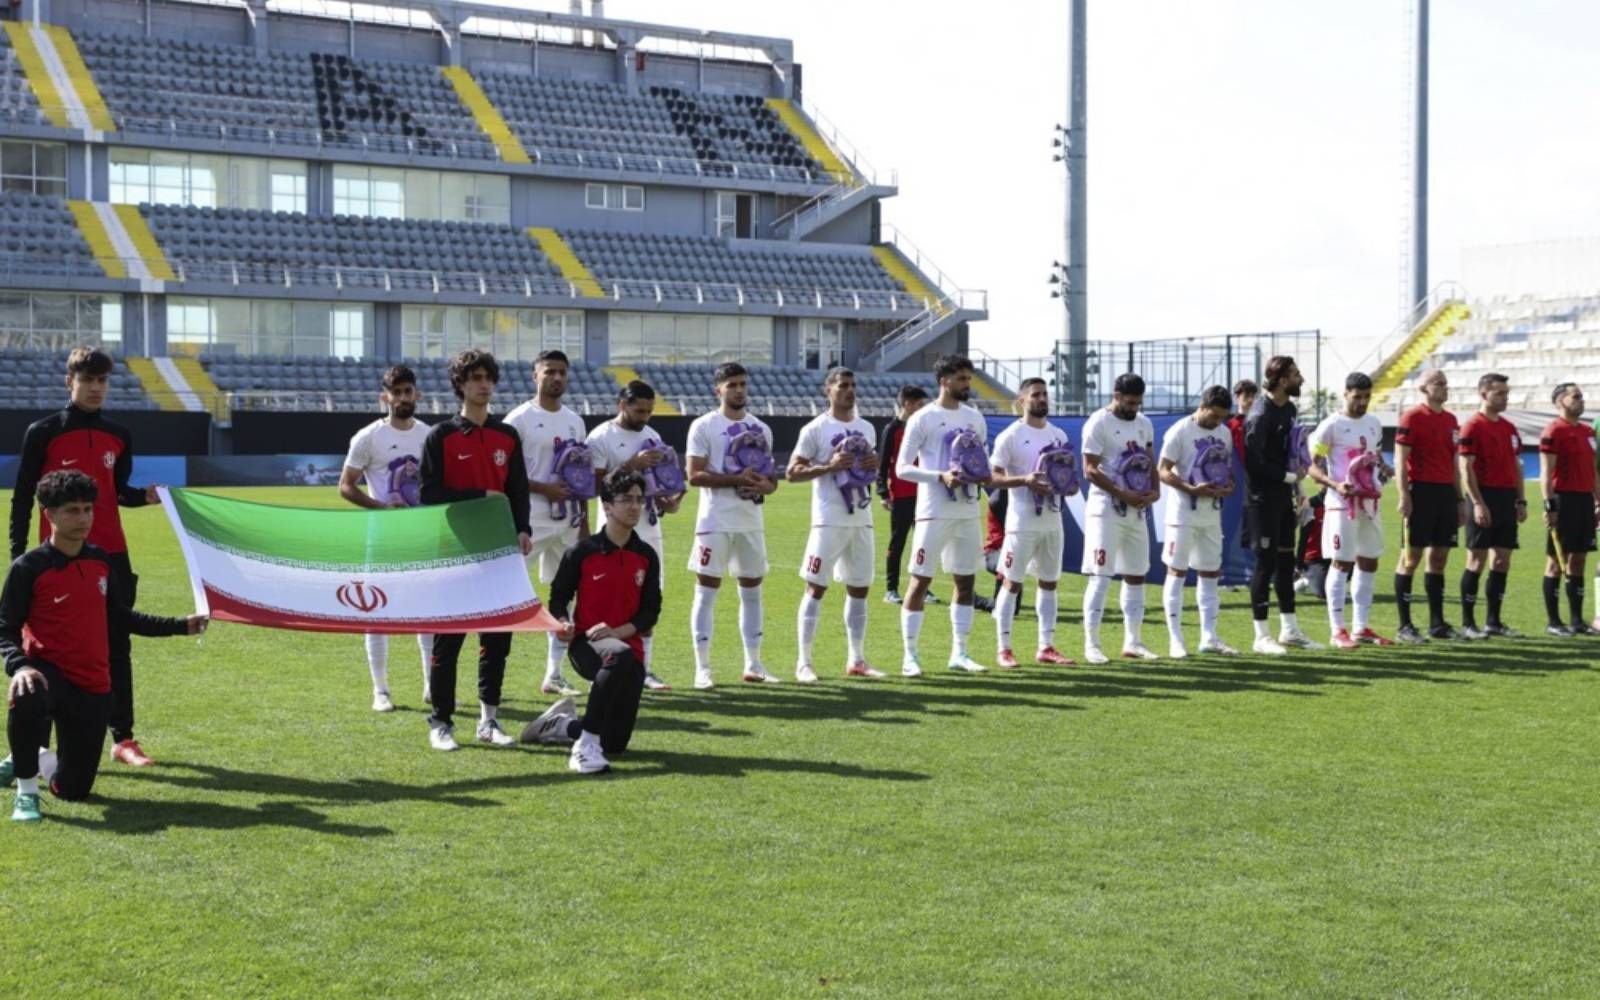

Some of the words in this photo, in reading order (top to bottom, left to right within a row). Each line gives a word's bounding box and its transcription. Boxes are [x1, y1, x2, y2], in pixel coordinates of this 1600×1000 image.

[1333, 534, 1341, 550] 9
[807, 555, 822, 575] 19
[916, 547, 926, 566] 6
[1005, 552, 1014, 568] 5
[1093, 549, 1106, 567] 13
